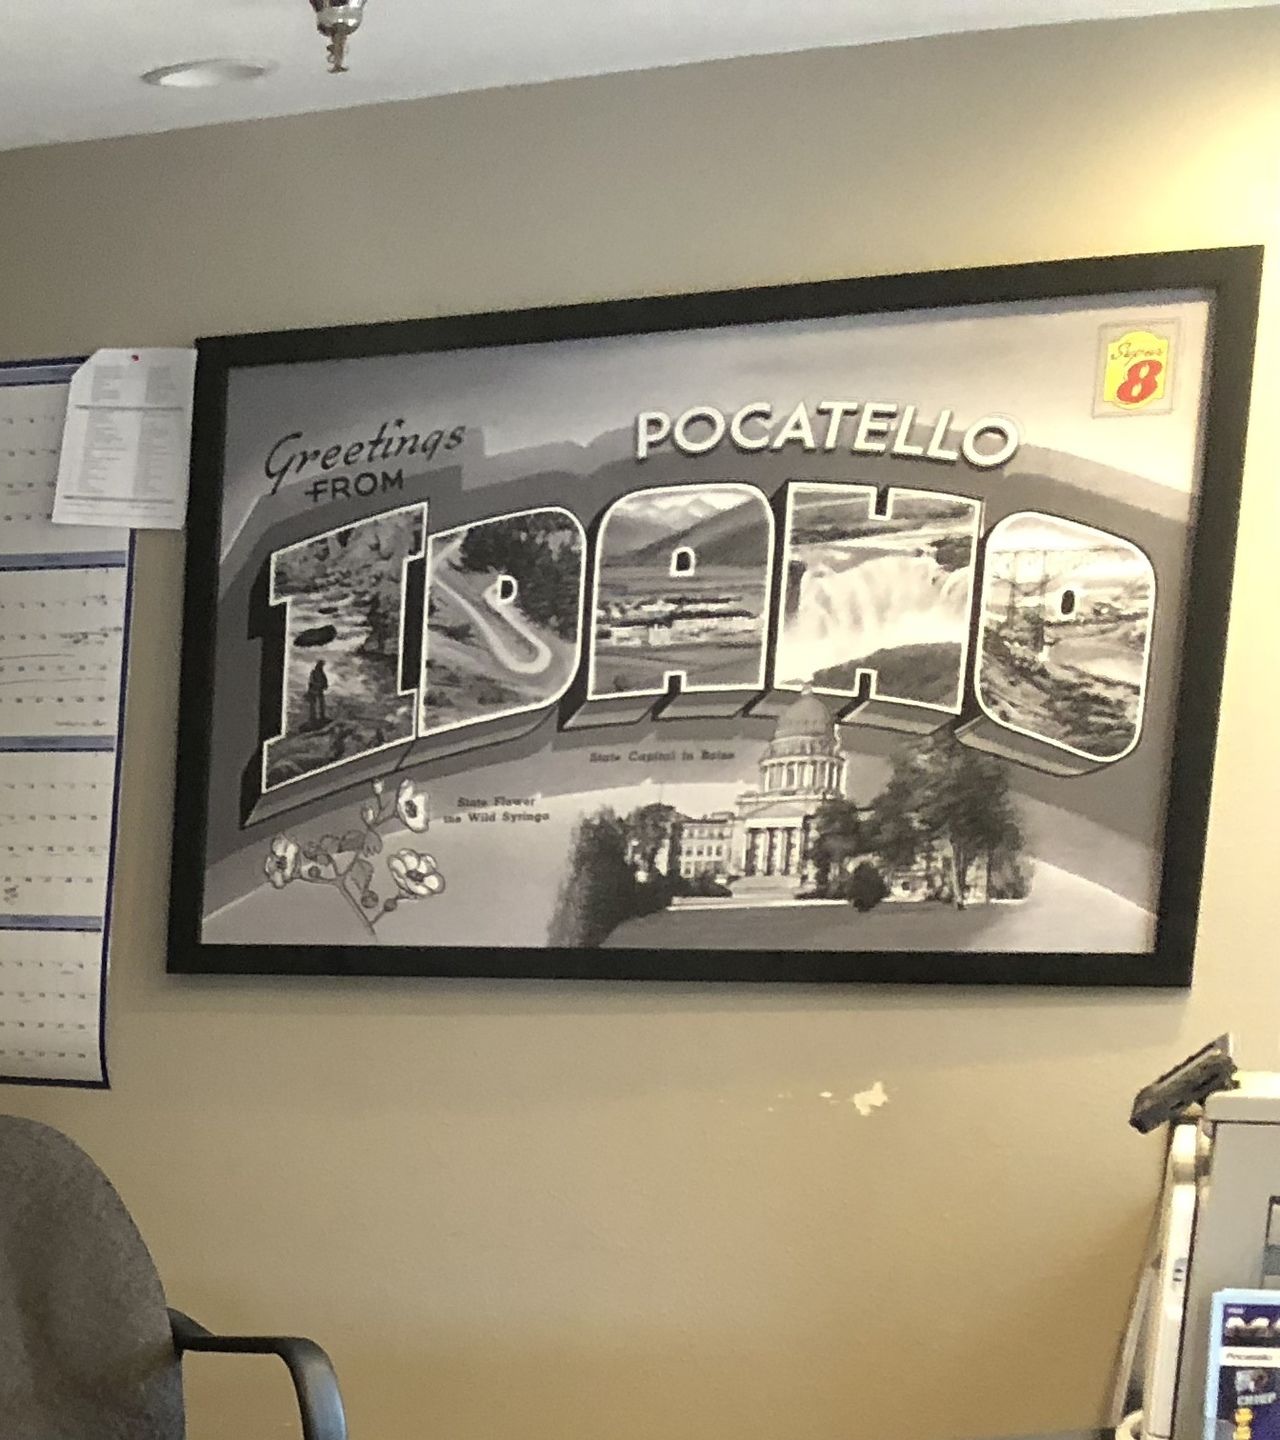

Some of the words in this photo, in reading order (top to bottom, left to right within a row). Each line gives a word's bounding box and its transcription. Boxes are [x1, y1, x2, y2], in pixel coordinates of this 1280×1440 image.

[1110, 342, 1163, 367] Super
[1116, 359, 1163, 404] 8
[636, 400, 1022, 469] POCATELLO
[264, 418, 467, 496] Greetings
[305, 467, 405, 502] FROM
[258, 480, 1158, 796] IDAHO
[457, 797, 487, 807] State
[494, 796, 535, 807] Flower
[468, 812, 496, 823] Wild
